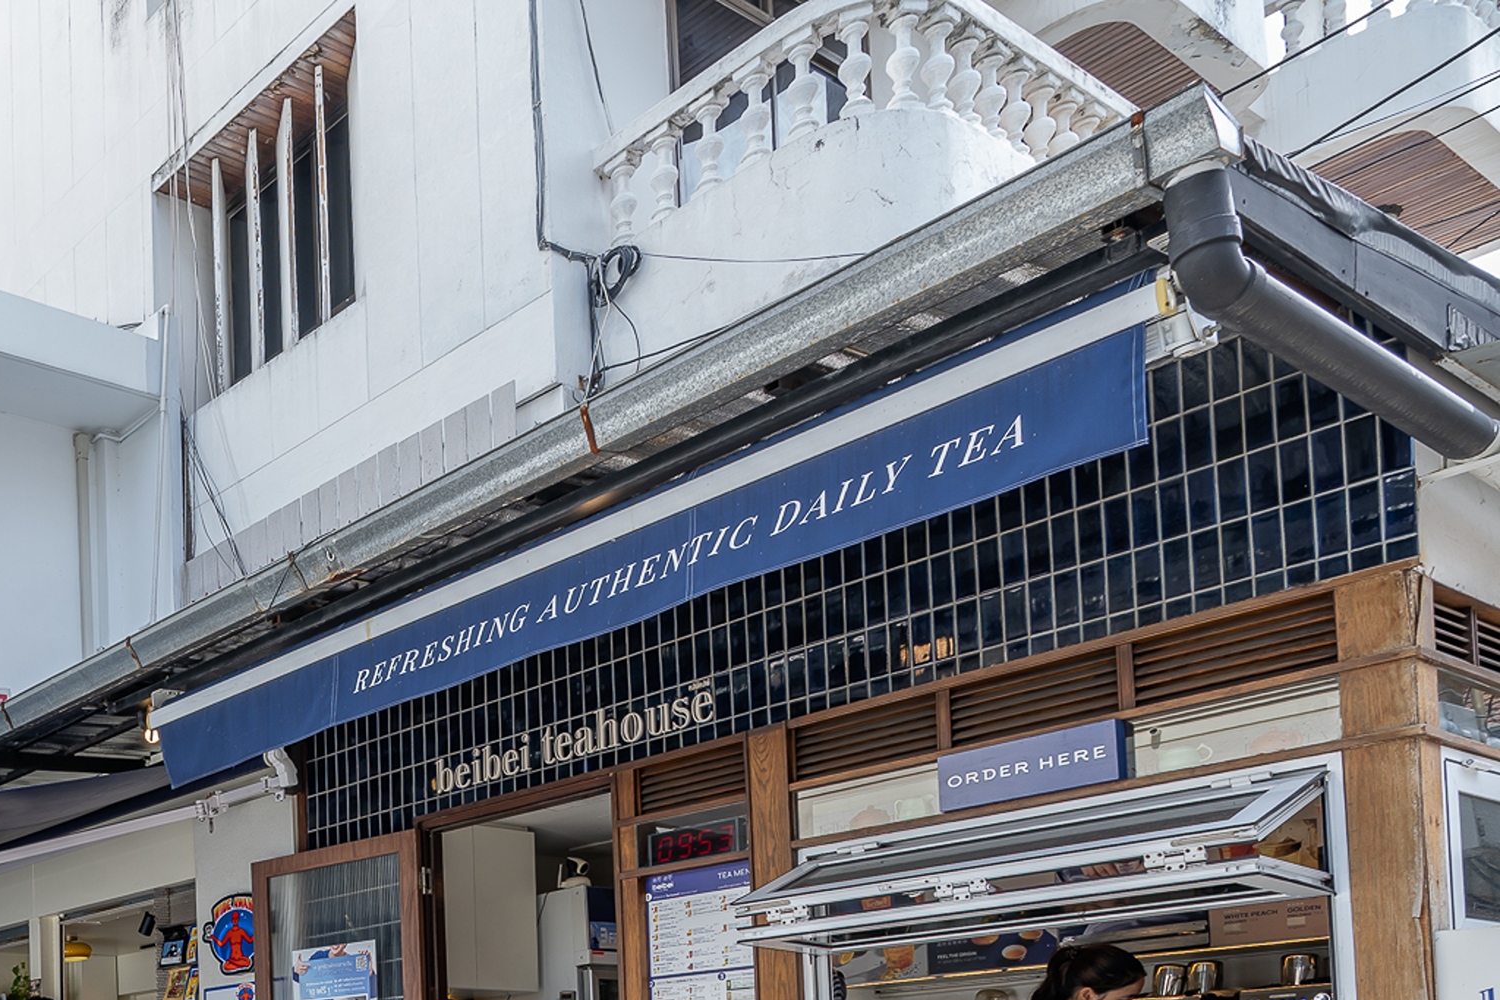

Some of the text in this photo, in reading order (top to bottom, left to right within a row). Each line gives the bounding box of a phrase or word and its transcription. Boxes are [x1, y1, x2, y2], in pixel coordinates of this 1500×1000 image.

[352, 414, 1025, 694] REFRESHING AUTHENTIC DAILY TEA
[435, 690, 714, 794] beibei teahouse
[947, 745, 1107, 788] ORDER HERE
[657, 825, 734, 863] 09:53
[717, 868, 750, 880] TEA MEN
[1224, 909, 1278, 920] WHITE PEACH
[1287, 904, 1321, 914] GOLDEN
